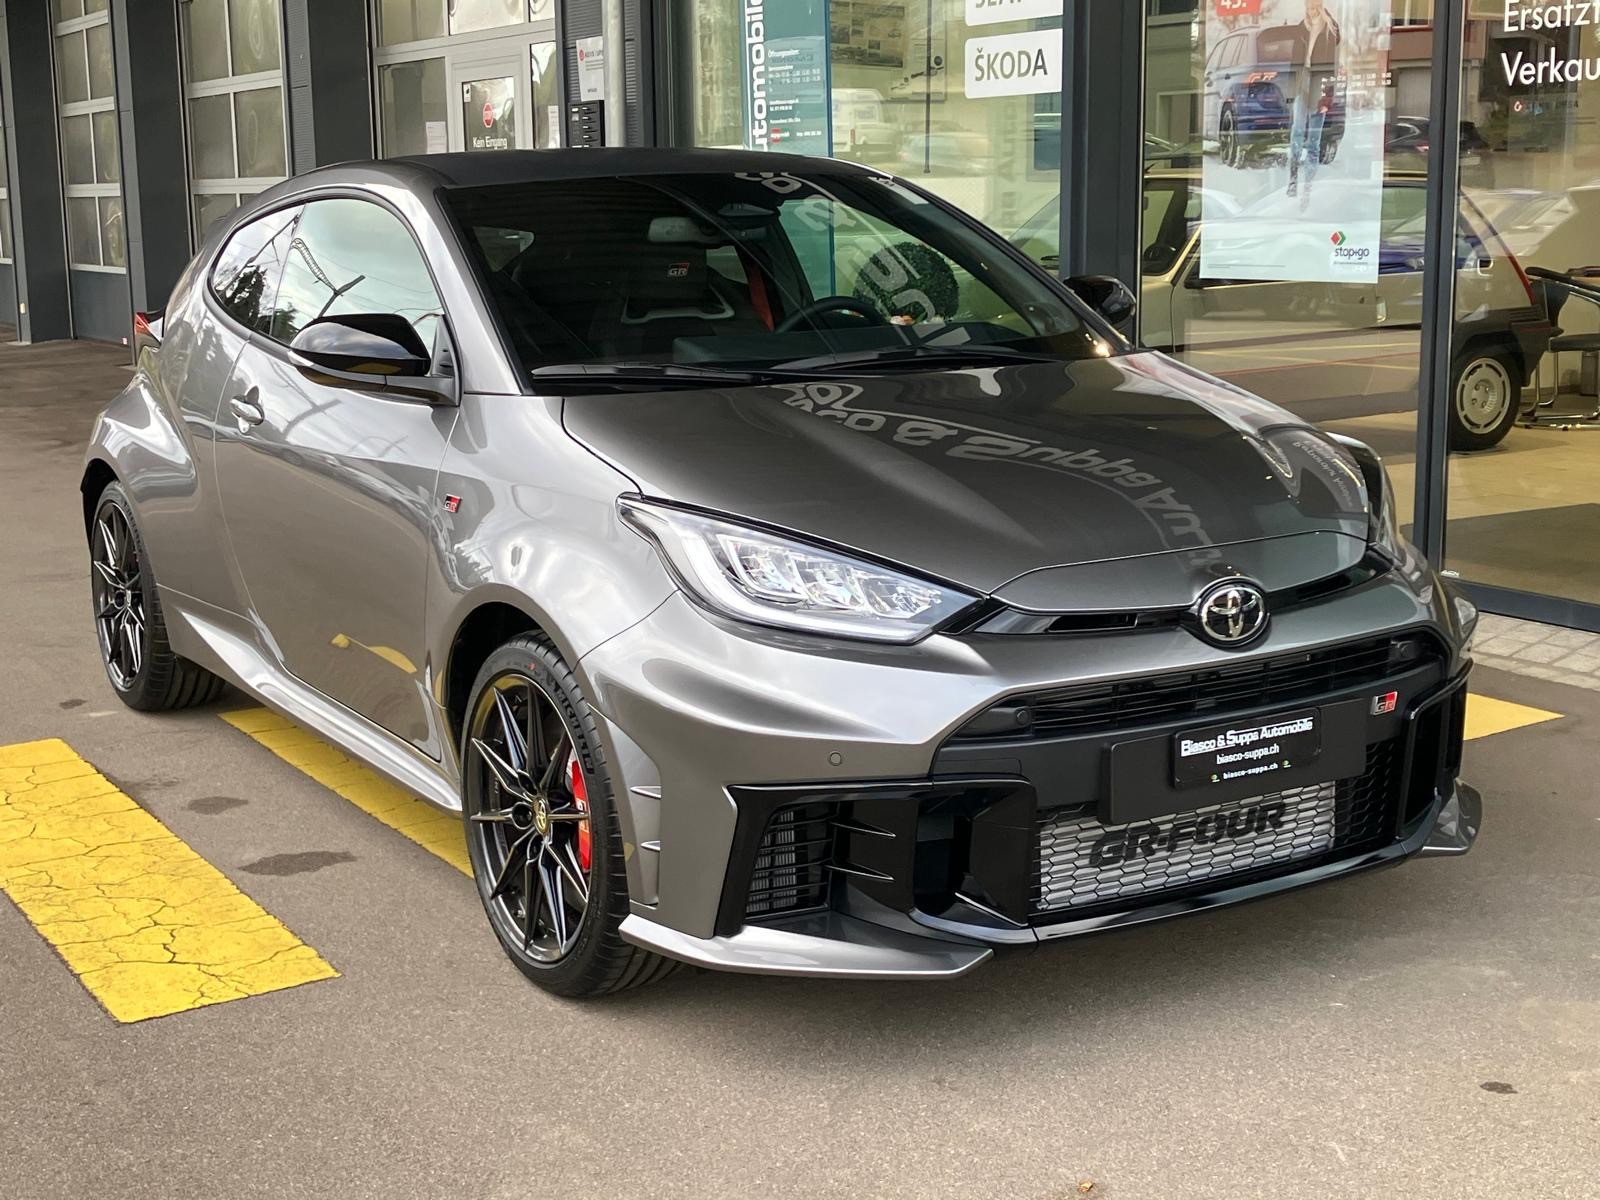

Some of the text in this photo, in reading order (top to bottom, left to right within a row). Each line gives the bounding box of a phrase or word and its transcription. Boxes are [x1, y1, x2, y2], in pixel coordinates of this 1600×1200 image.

[745, 0, 768, 152] utomobil
[975, 48, 1048, 82] ŠKODA
[473, 136, 508, 150] Kein Eingang
[1181, 719, 1314, 757] Biasco & Suppa Automobile
[1216, 743, 1280, 765] biasco-suppa.ch
[1223, 762, 1279, 780] biasco-suppa.ch
[1088, 800, 1286, 866] GR-FOUR
